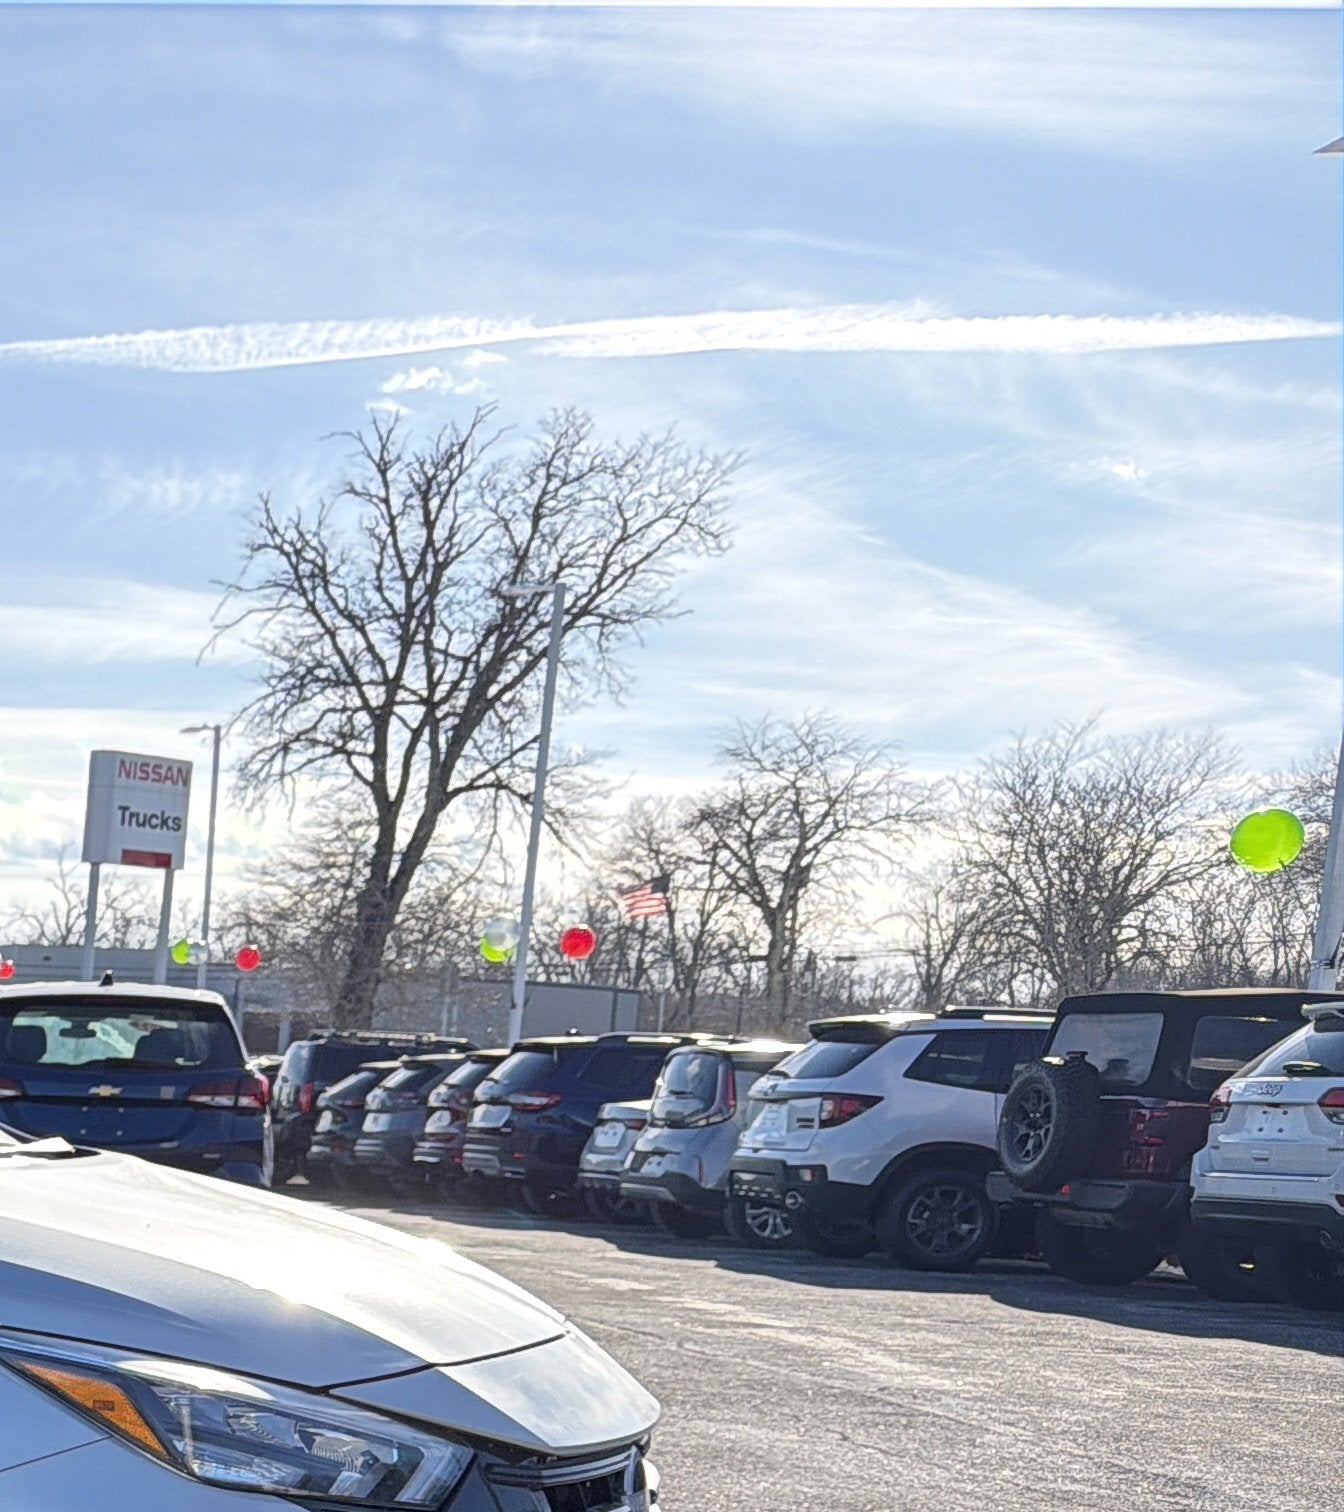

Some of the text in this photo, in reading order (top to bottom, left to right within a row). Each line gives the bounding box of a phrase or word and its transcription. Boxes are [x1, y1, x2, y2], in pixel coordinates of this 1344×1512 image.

[118, 760, 189, 786] NISSAN
[118, 805, 182, 832] Trucks
[1257, 1083, 1283, 1097] Jeep
